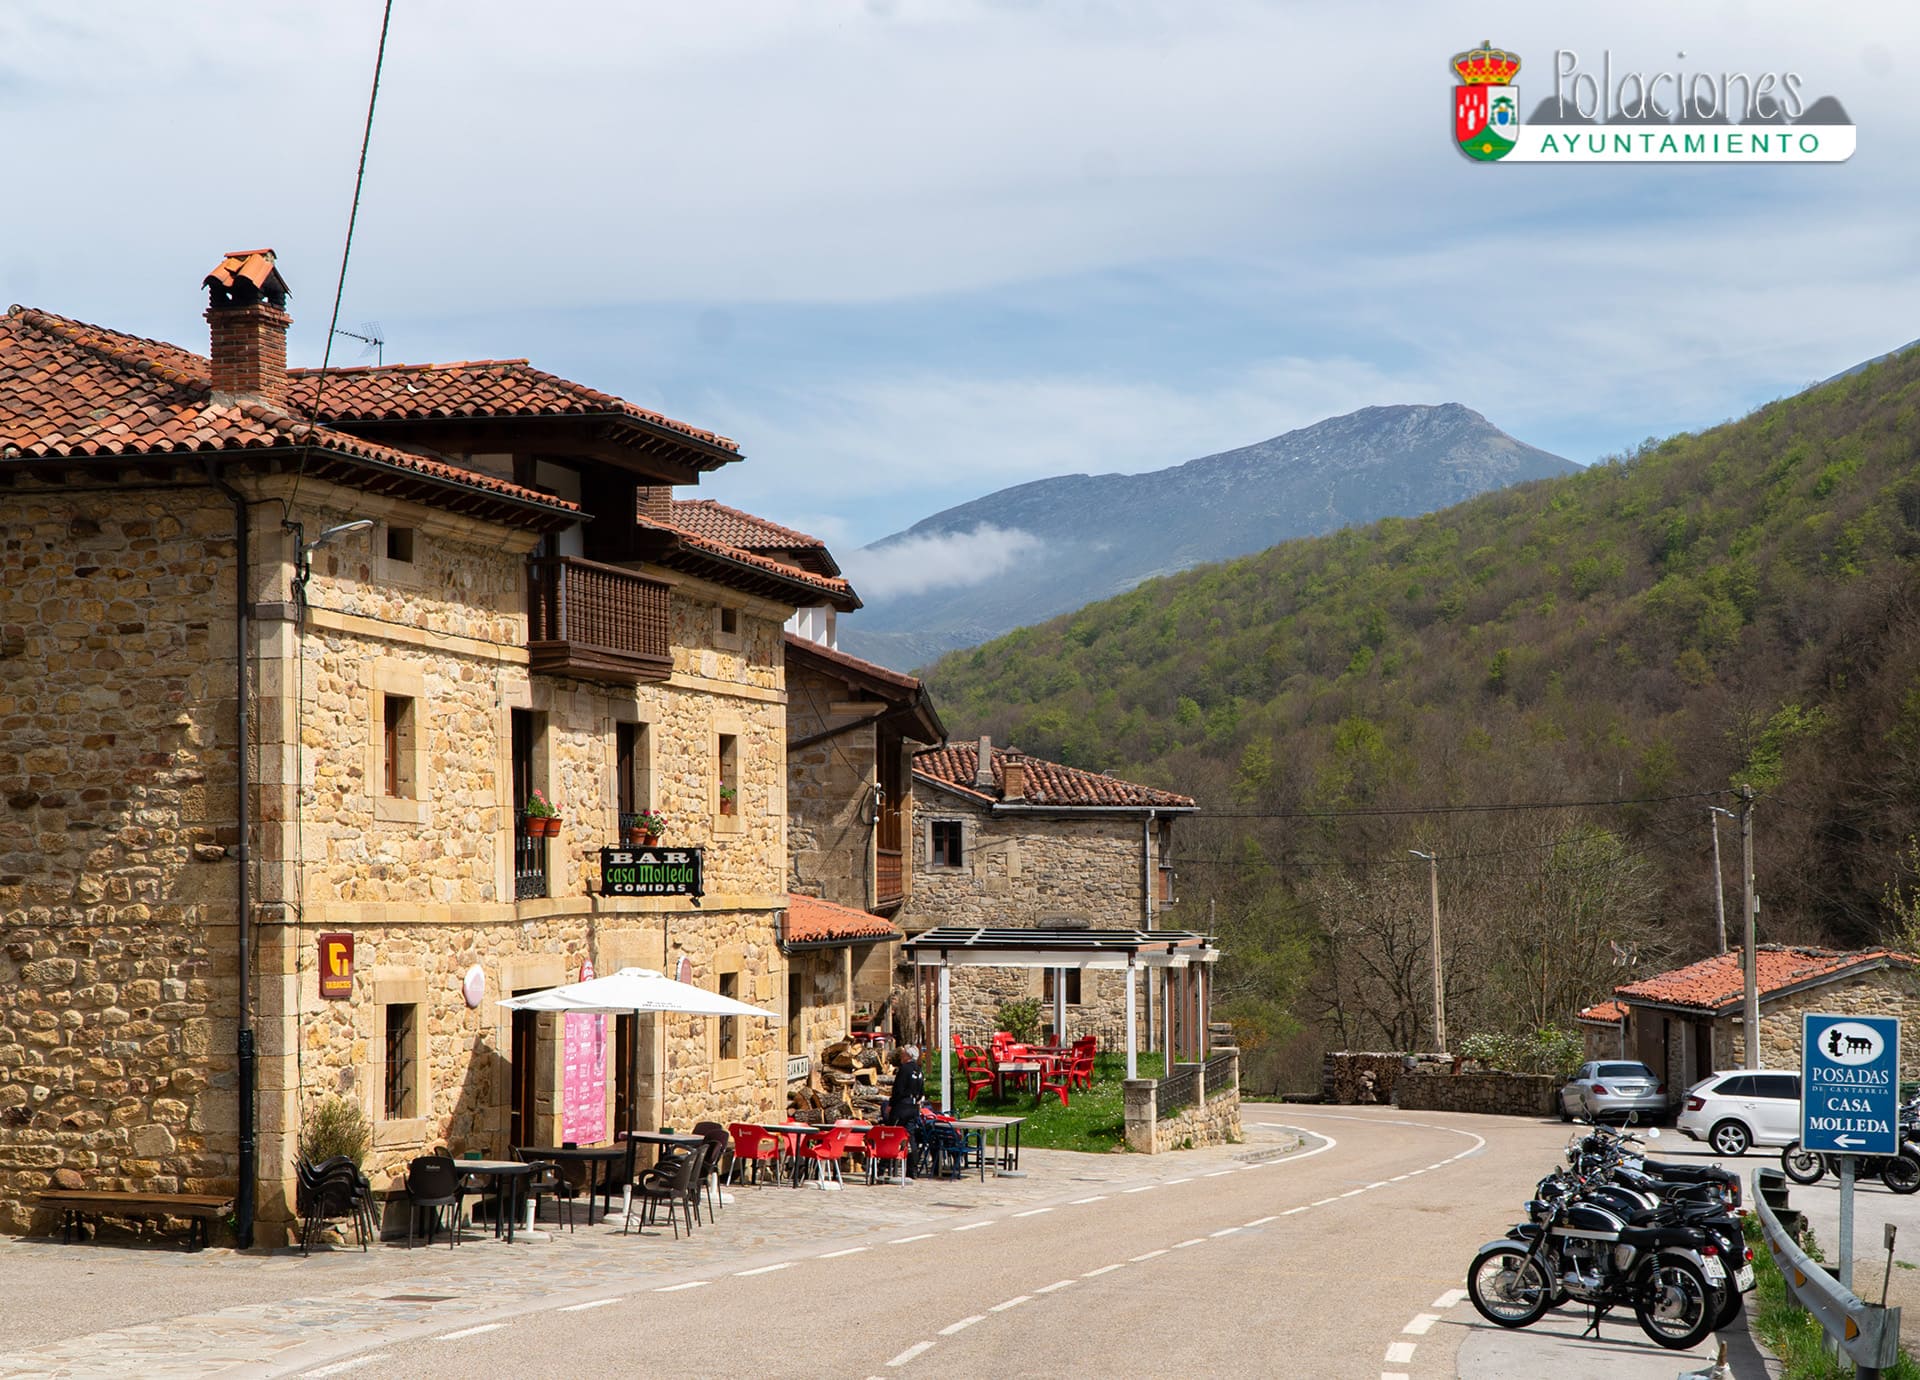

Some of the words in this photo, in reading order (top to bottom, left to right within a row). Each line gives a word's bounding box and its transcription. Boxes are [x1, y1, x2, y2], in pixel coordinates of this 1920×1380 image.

[609, 852, 690, 864] BAR
[606, 867, 635, 883] casa
[639, 864, 694, 883] Molleda
[614, 884, 686, 892] COMIDAS
[1812, 1067, 1889, 1084] POSADAS
[1829, 1087, 1889, 1095] CANTABRIA
[1827, 1097, 1872, 1112] CASA
[1810, 1117, 1889, 1133] MOLLEDA
